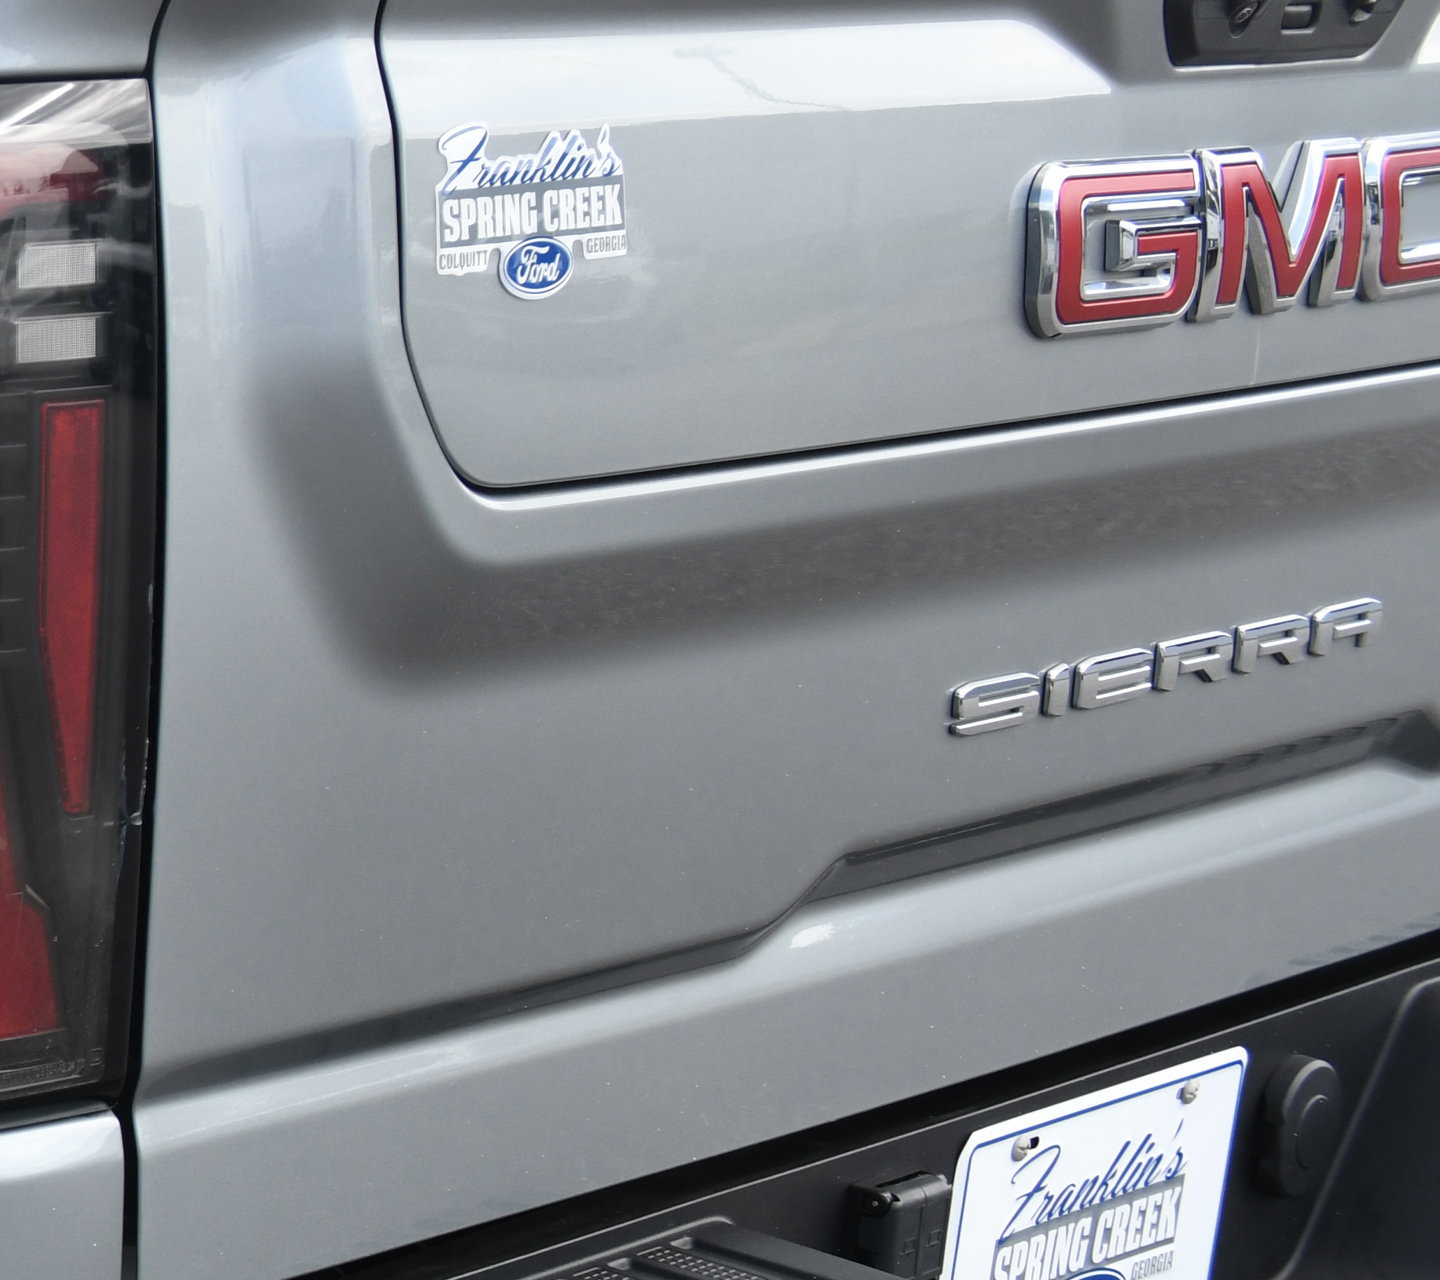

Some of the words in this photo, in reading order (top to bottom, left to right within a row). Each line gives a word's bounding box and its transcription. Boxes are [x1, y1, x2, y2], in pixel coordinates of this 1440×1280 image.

[440, 125, 622, 197] Franklin's
[442, 191, 539, 243] SPRING
[543, 183, 623, 233] CREEK
[586, 234, 627, 254] GEORGIA
[439, 249, 491, 271] COLQUITT
[516, 245, 561, 286] Ford
[946, 596, 1383, 737] SIERRA
[997, 1118, 1188, 1246] Franklin's
[1089, 1186, 1182, 1265] CREEK
